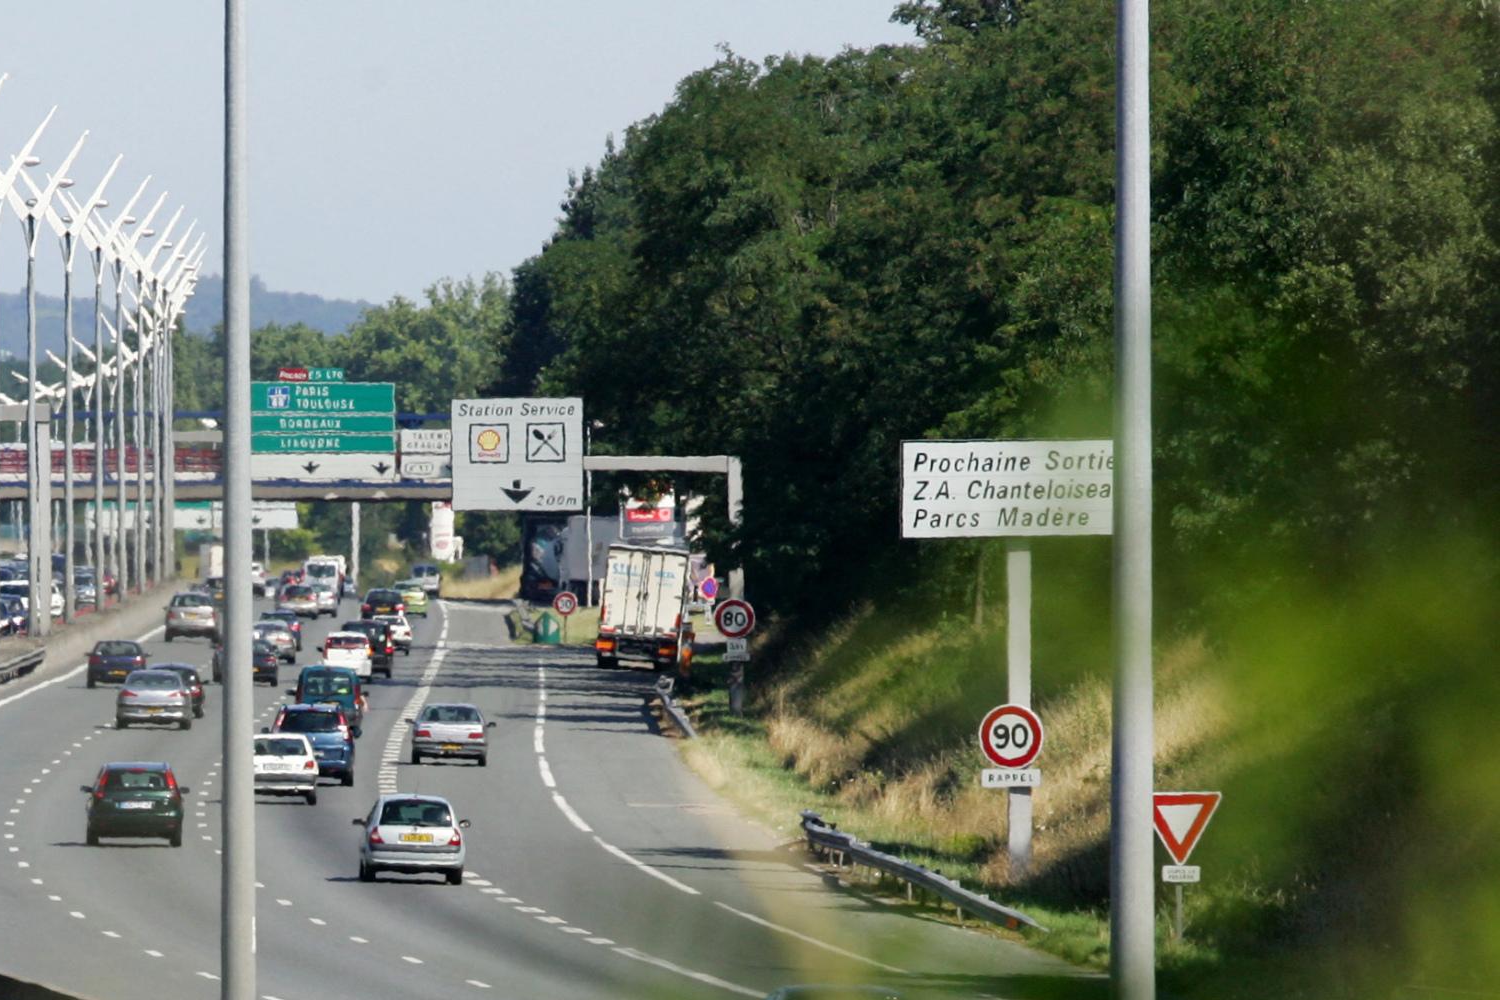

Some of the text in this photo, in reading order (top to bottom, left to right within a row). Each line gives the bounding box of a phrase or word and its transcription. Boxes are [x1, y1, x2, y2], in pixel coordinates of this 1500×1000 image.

[295, 385, 329, 396] PARIS
[296, 398, 355, 409] TOULOUSE
[458, 403, 575, 416] Station Service
[279, 418, 341, 429] BORDEAUX
[913, 450, 1113, 472] Prochaine Sortie
[913, 480, 956, 501] Z.A.
[913, 507, 1090, 528] Parcs Madère
[723, 611, 746, 626] 80
[993, 723, 1029, 749] 90
[988, 773, 1034, 782] RAPPEL
